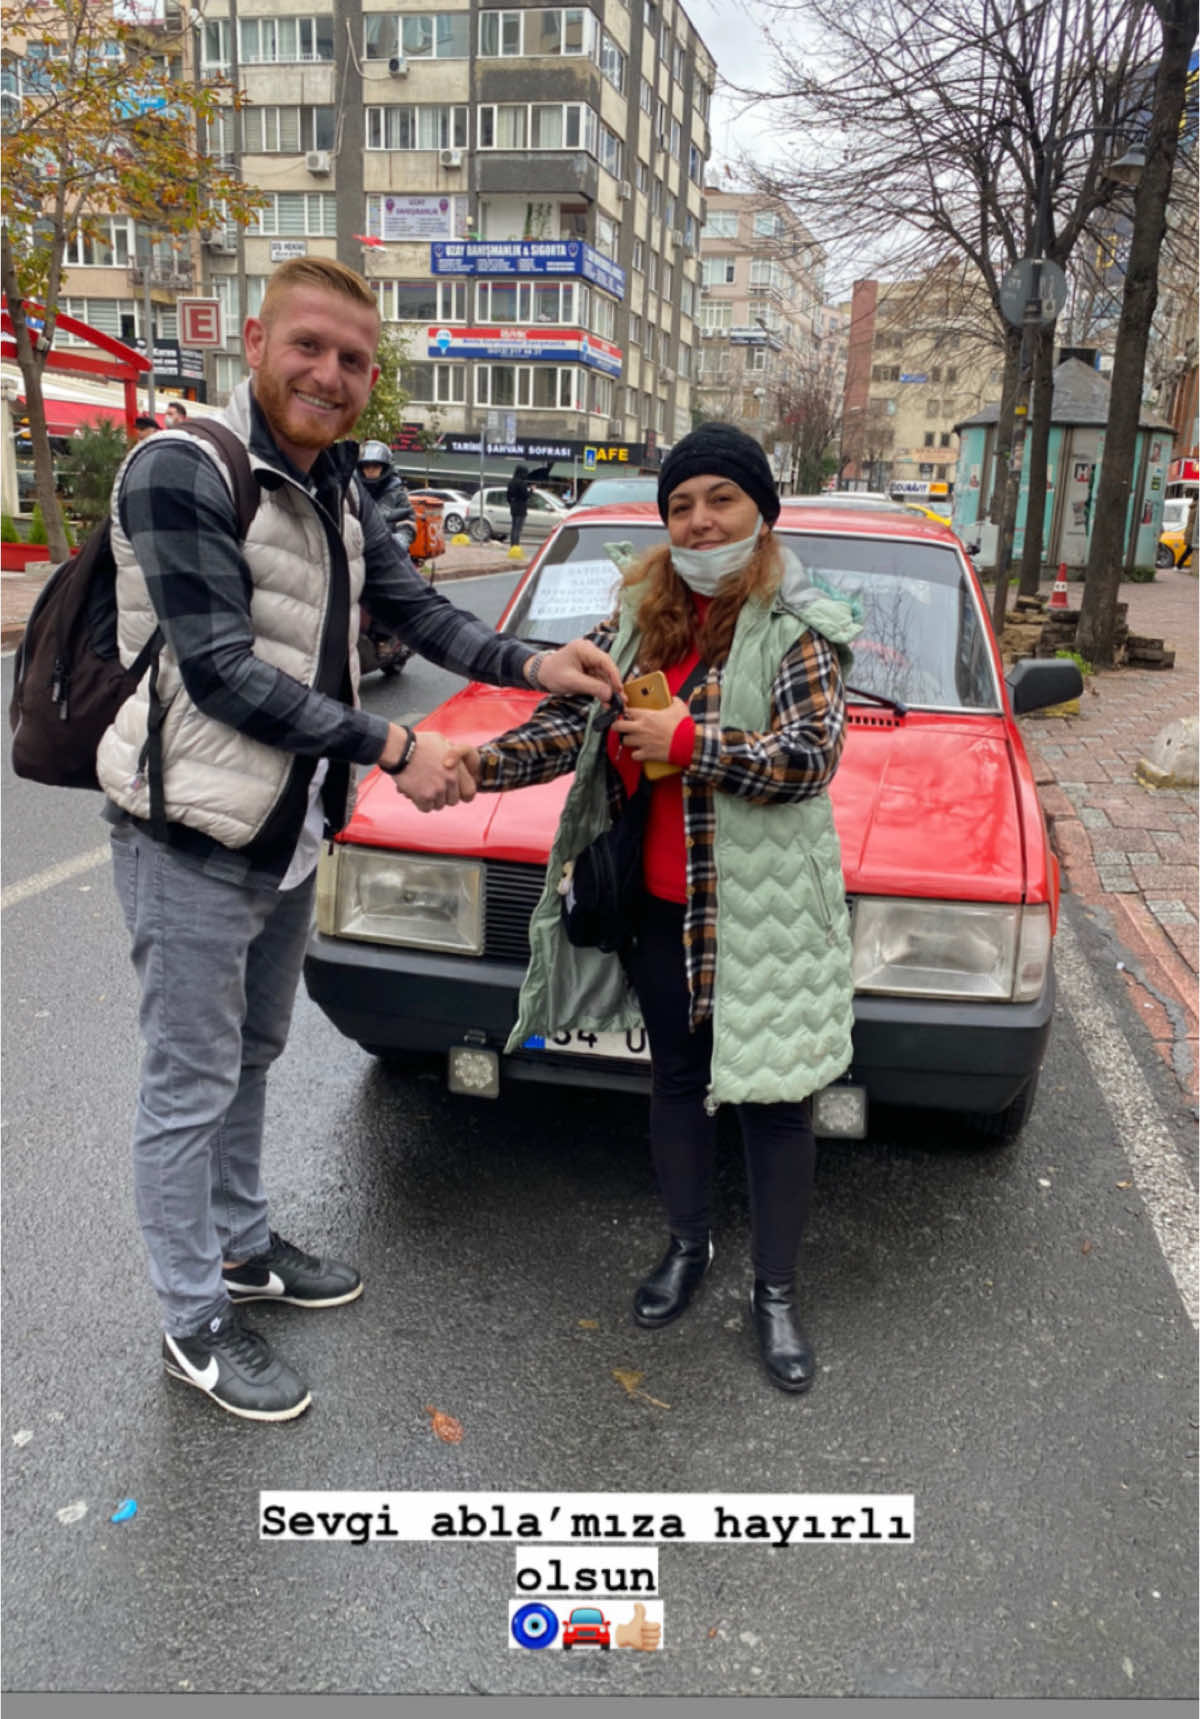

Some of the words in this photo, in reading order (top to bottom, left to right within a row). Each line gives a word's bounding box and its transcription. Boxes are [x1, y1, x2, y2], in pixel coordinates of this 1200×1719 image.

[189, 309, 214, 339] E
[528, 446, 571, 457] SOFRASI
[596, 448, 629, 461] AFE
